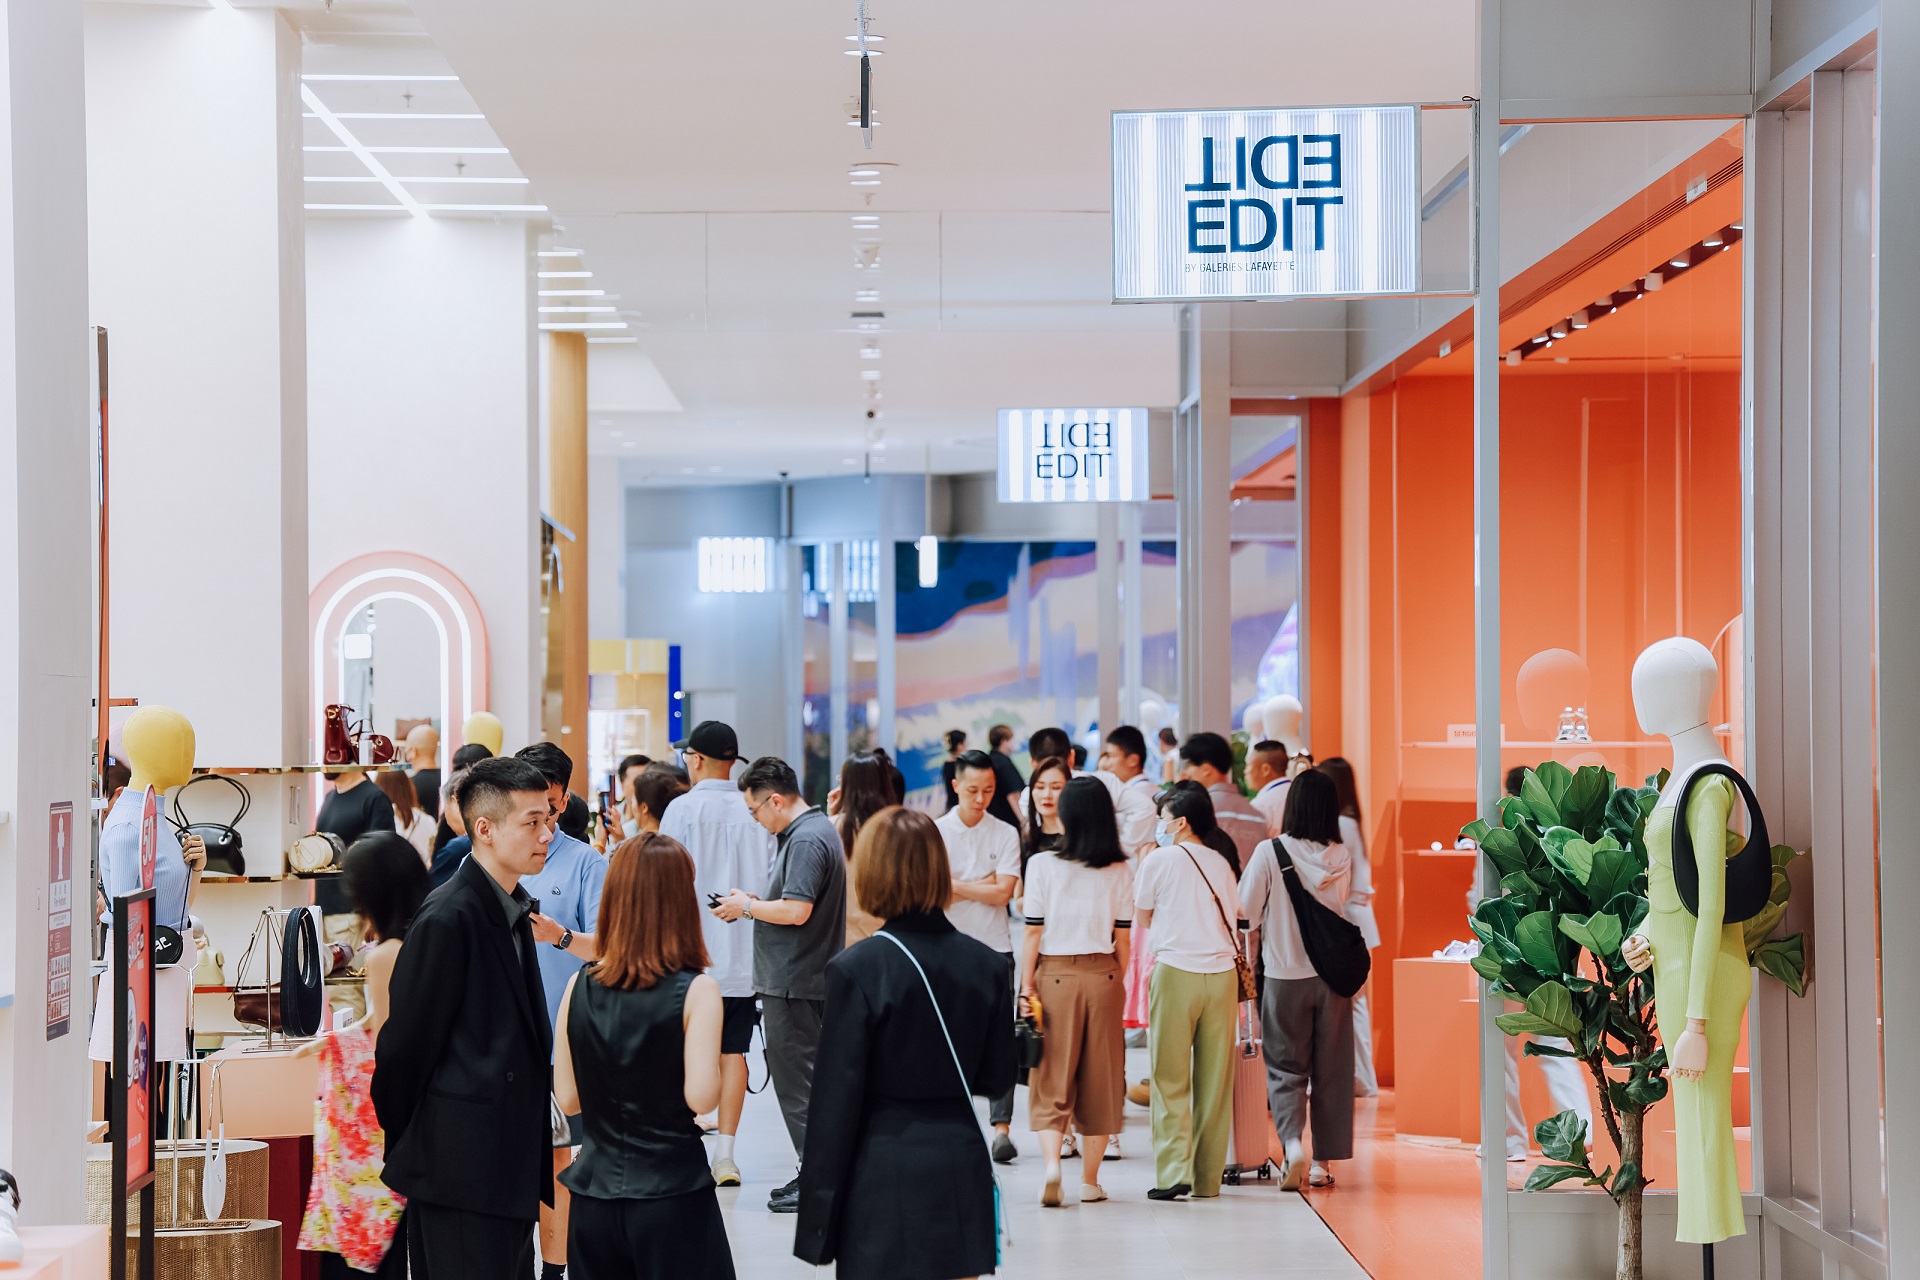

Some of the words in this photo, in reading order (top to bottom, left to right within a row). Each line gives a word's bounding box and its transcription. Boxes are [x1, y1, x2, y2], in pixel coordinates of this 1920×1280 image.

[1184, 133, 1342, 192] EDIT
[1187, 195, 1344, 254] EDIT
[1185, 263, 1197, 273] BY
[1200, 262, 1243, 273] GALERIES
[1245, 260, 1295, 272] LAFAYETTE
[1035, 422, 1111, 448] EDIT
[1036, 453, 1112, 479] EDIT
[142, 815, 154, 866] 50
